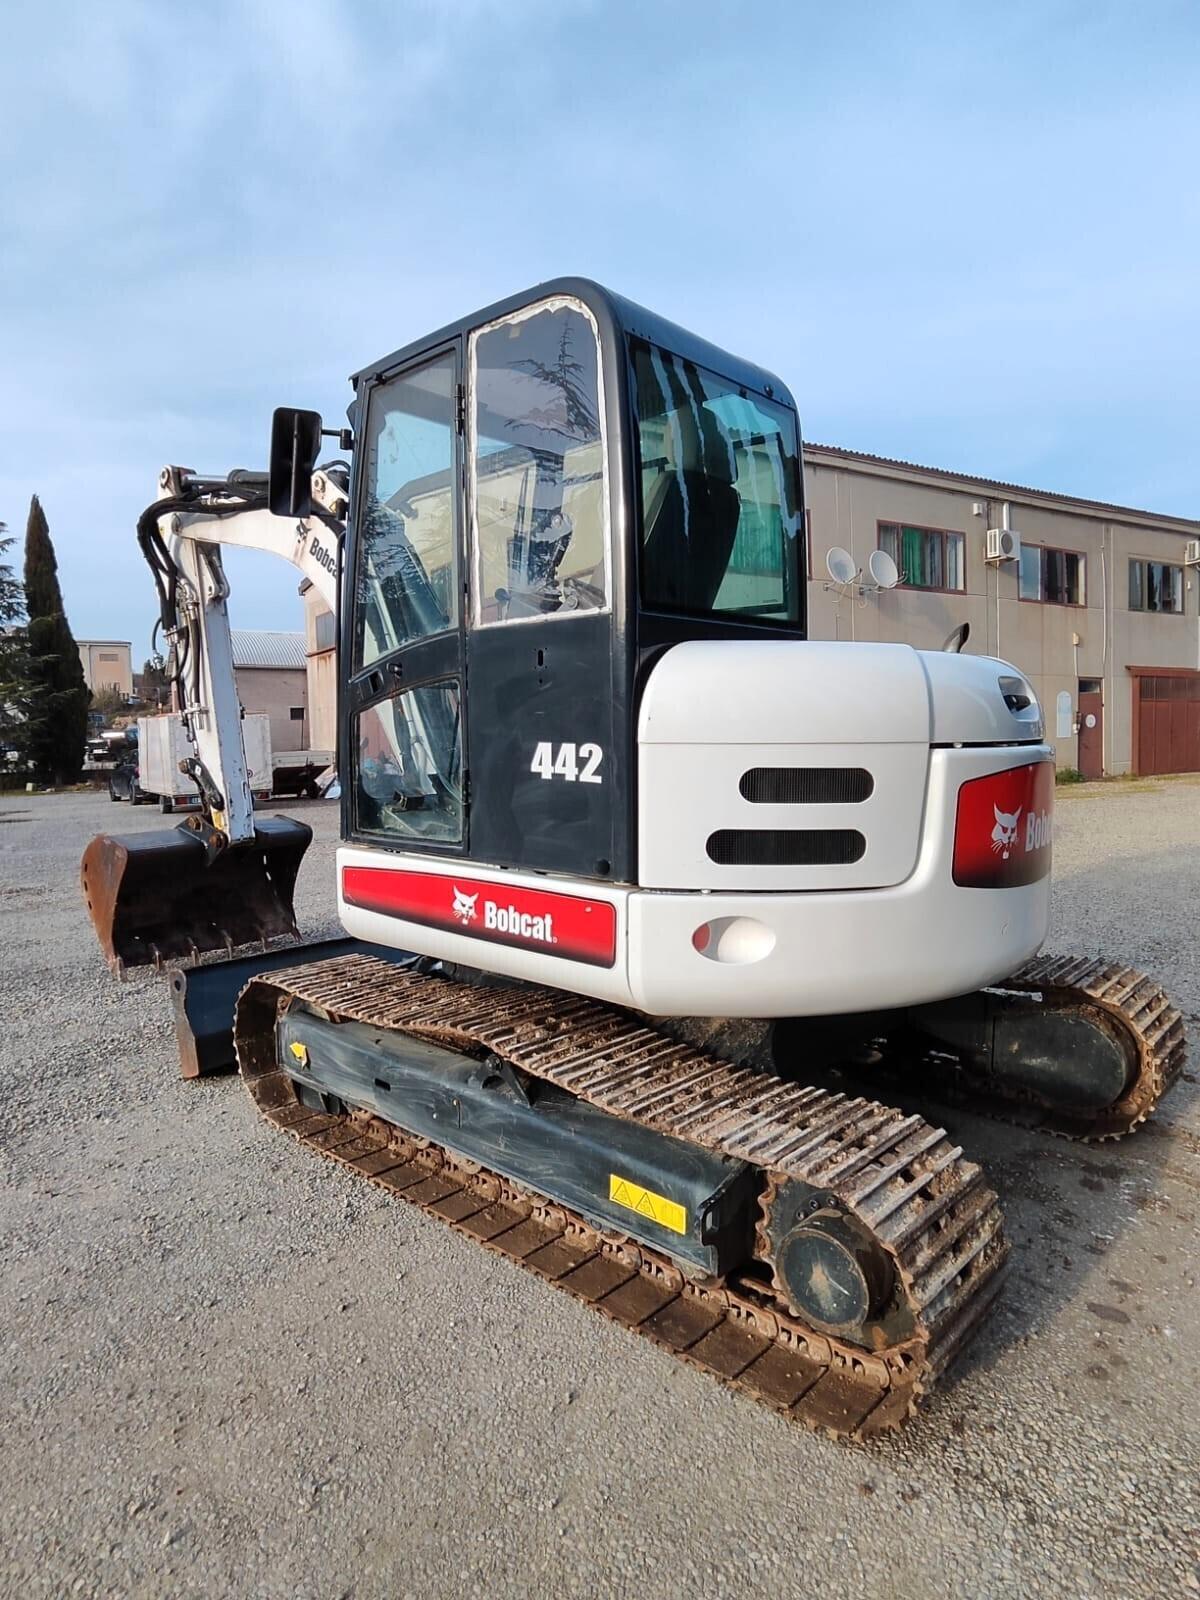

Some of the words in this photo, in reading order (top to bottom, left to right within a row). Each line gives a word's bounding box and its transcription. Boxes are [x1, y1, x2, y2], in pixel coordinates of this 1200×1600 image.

[309, 536, 338, 580] Bobca
[530, 742, 603, 784] 442
[484, 900, 554, 943] Bobcat
